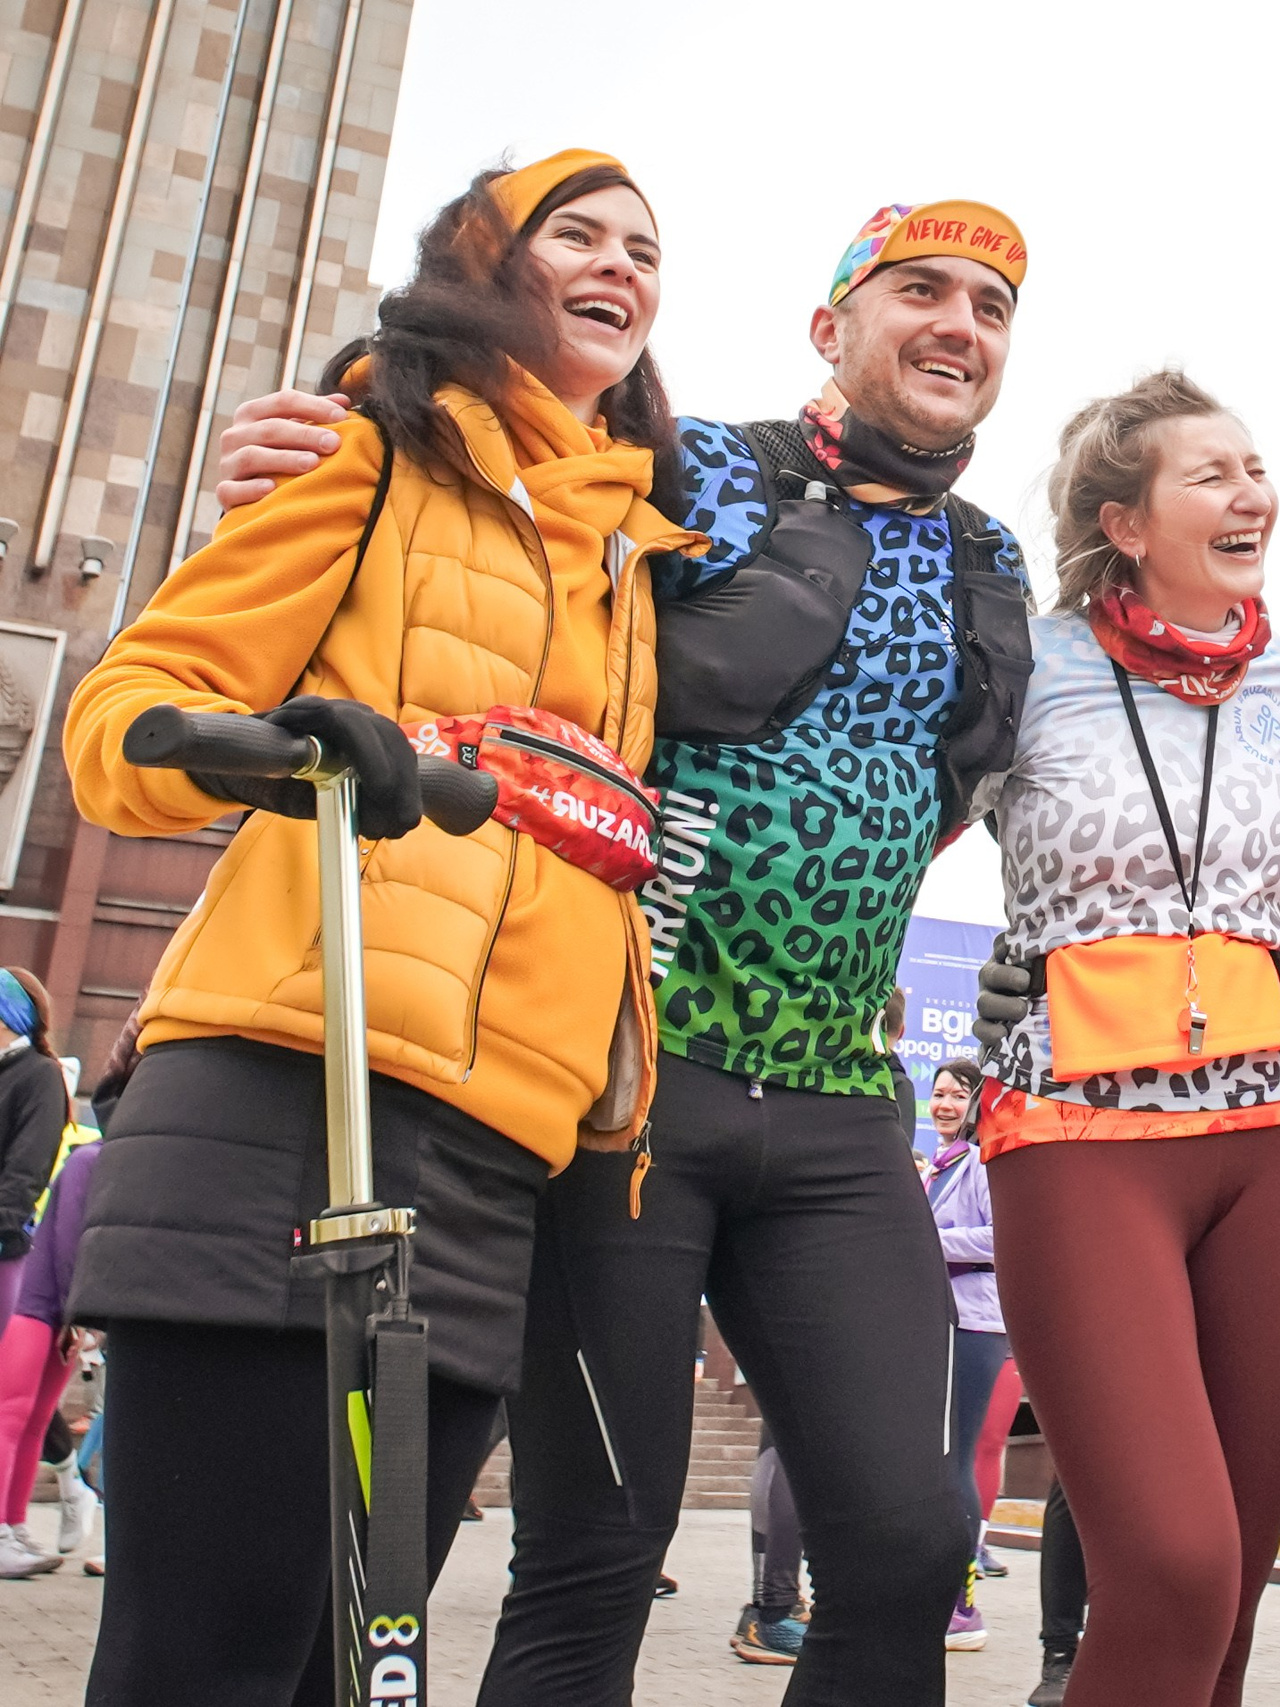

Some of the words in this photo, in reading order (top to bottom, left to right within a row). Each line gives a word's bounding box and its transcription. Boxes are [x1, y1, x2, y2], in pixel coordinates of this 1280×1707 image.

[906, 218, 967, 243] NEVER
[970, 225, 1009, 252] GIVE
[1005, 241, 1026, 264] UP
